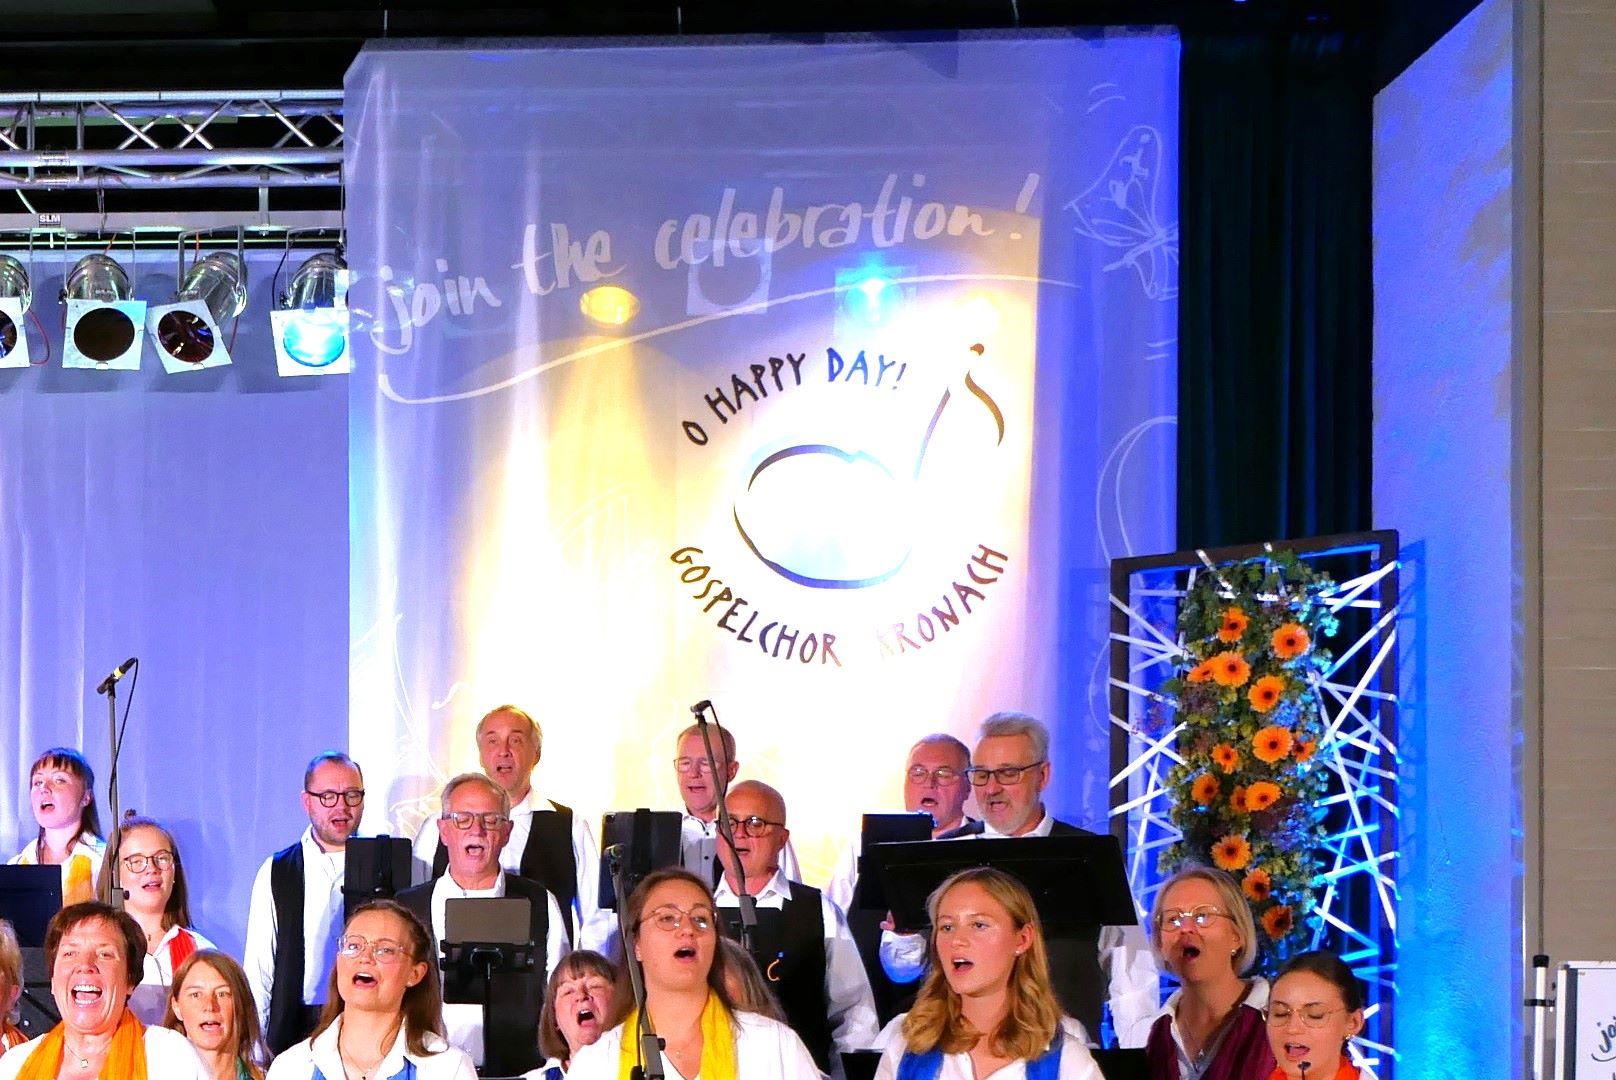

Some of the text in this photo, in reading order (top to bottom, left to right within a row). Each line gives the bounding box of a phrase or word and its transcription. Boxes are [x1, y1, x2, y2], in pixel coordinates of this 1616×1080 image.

[370, 264, 503, 356] join
[511, 223, 628, 296] the
[681, 347, 907, 446] O HAPPY DAY!
[670, 543, 1009, 667] GOSPELCHOR KRONACH
